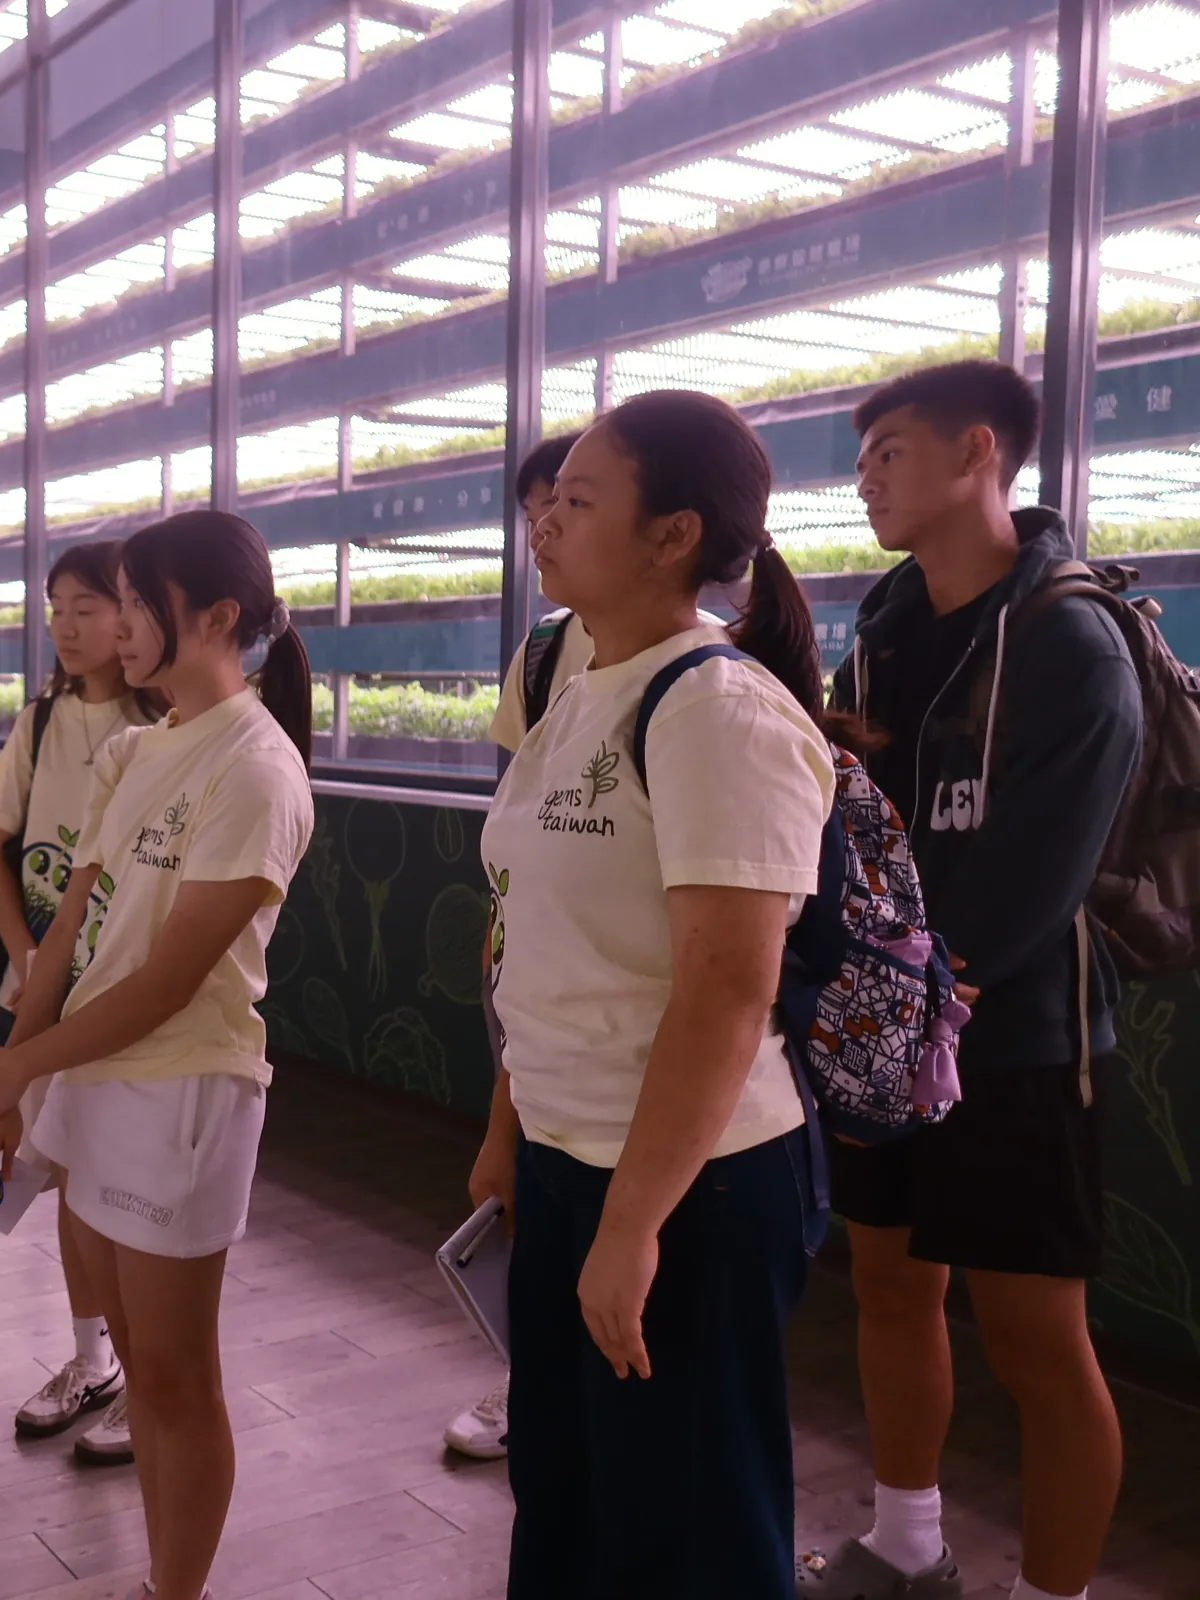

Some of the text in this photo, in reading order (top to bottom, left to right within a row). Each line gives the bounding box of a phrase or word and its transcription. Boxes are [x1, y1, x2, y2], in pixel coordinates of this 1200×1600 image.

[537, 788, 582, 820] gens
[543, 810, 615, 837] taiwan
[136, 848, 181, 871] taiwan
